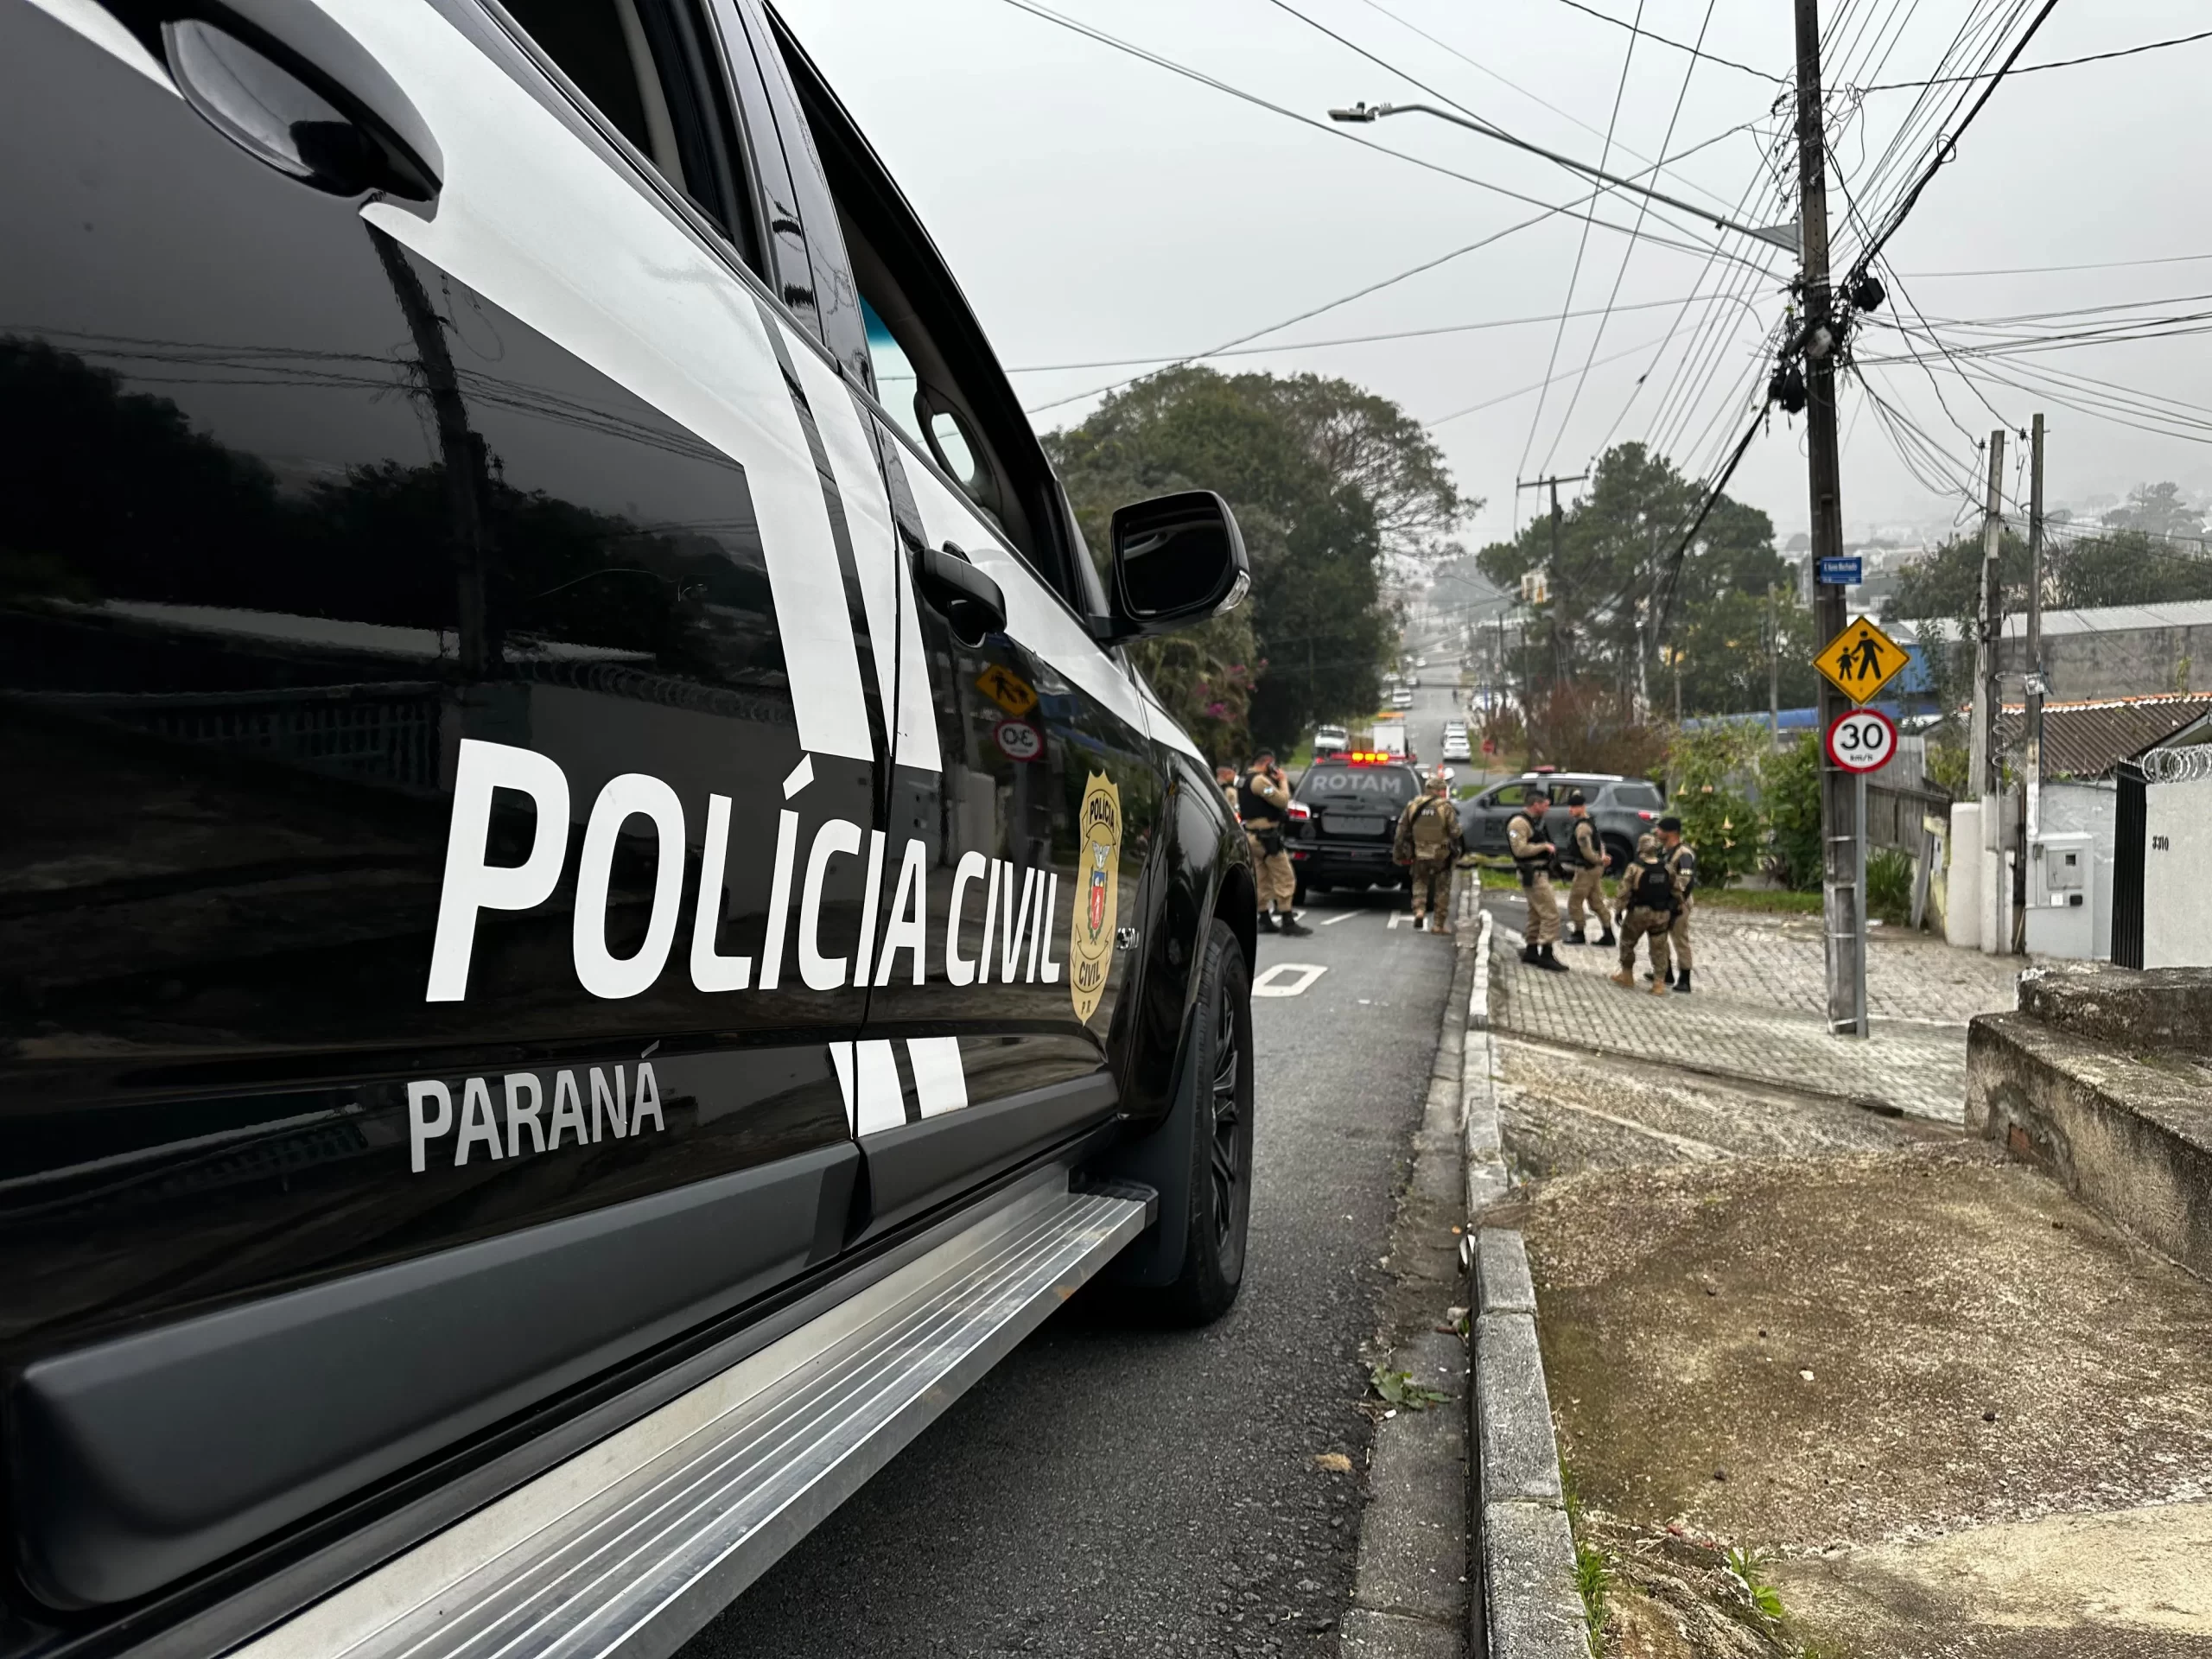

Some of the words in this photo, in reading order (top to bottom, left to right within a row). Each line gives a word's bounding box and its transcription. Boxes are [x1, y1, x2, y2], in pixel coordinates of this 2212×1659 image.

[1840, 722, 1883, 751] 30
[1312, 773, 1402, 794] ROTAM
[1090, 792, 1115, 834] POLÍCIA
[426, 739, 925, 1002] POLÍCIA
[945, 850, 1061, 987] CIVIL
[1078, 960, 1101, 987] CIVIL
[406, 1039, 665, 1173] PARANÁ
